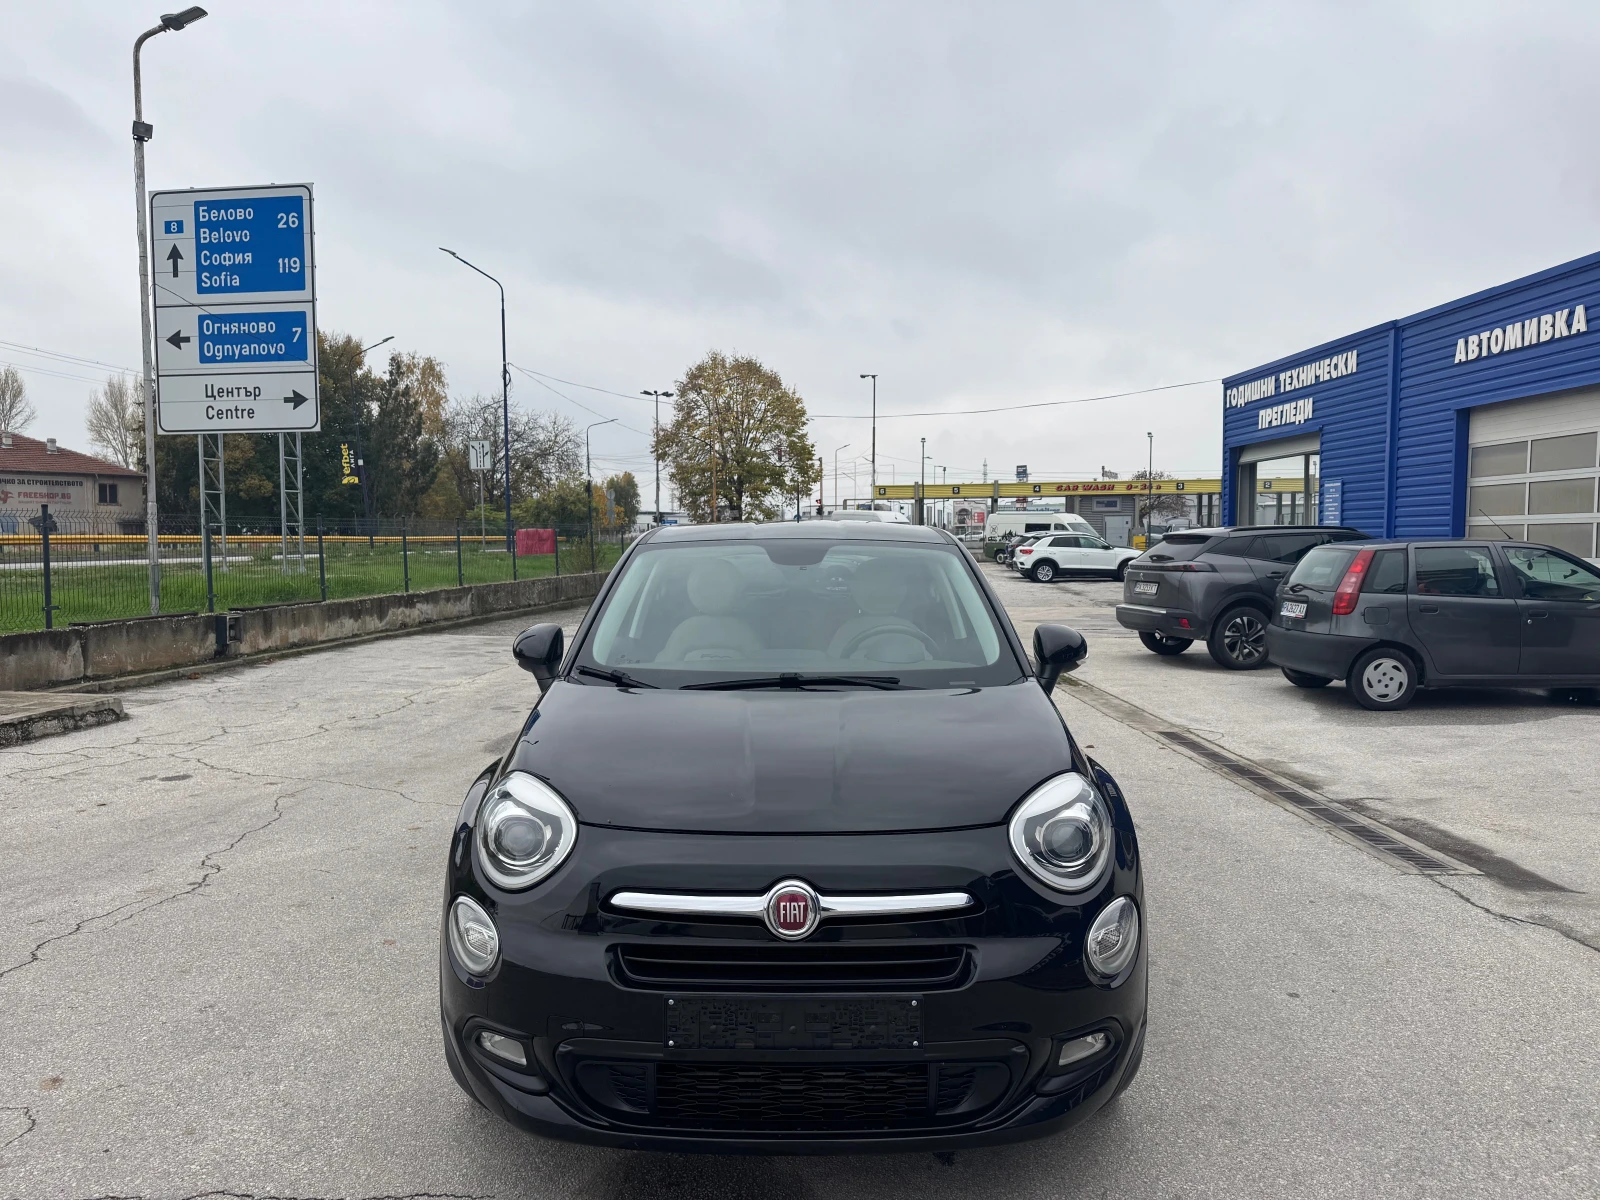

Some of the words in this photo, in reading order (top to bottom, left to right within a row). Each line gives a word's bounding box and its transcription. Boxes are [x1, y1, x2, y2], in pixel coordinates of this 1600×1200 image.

[198, 206, 254, 222] Белово
[277, 212, 299, 229] 26
[170, 222, 178, 233] 8
[200, 228, 250, 244] Belovo
[200, 250, 252, 268] София
[278, 257, 300, 273] 119
[201, 272, 240, 287] Sofia
[203, 319, 276, 335] Огняново
[292, 327, 302, 343] 7
[1454, 304, 1588, 364] АВТОМИВКА
[203, 341, 286, 360] Ognyanovo
[1226, 375, 1276, 408] ГОДИШНИ
[1279, 349, 1358, 393] ТЕХНИЧЕСКИ
[204, 383, 262, 400] Център
[205, 405, 255, 420] Centre
[1258, 397, 1314, 430] ПРЕГЛЕДИ
[340, 443, 351, 475] efbet
[27, 478, 84, 487] СТРОИТЕЛСТВОТО
[1082, 483, 1115, 491] WASH
[17, 491, 72, 500] FREESHOP.BG
[780, 901, 806, 923] FIAT
